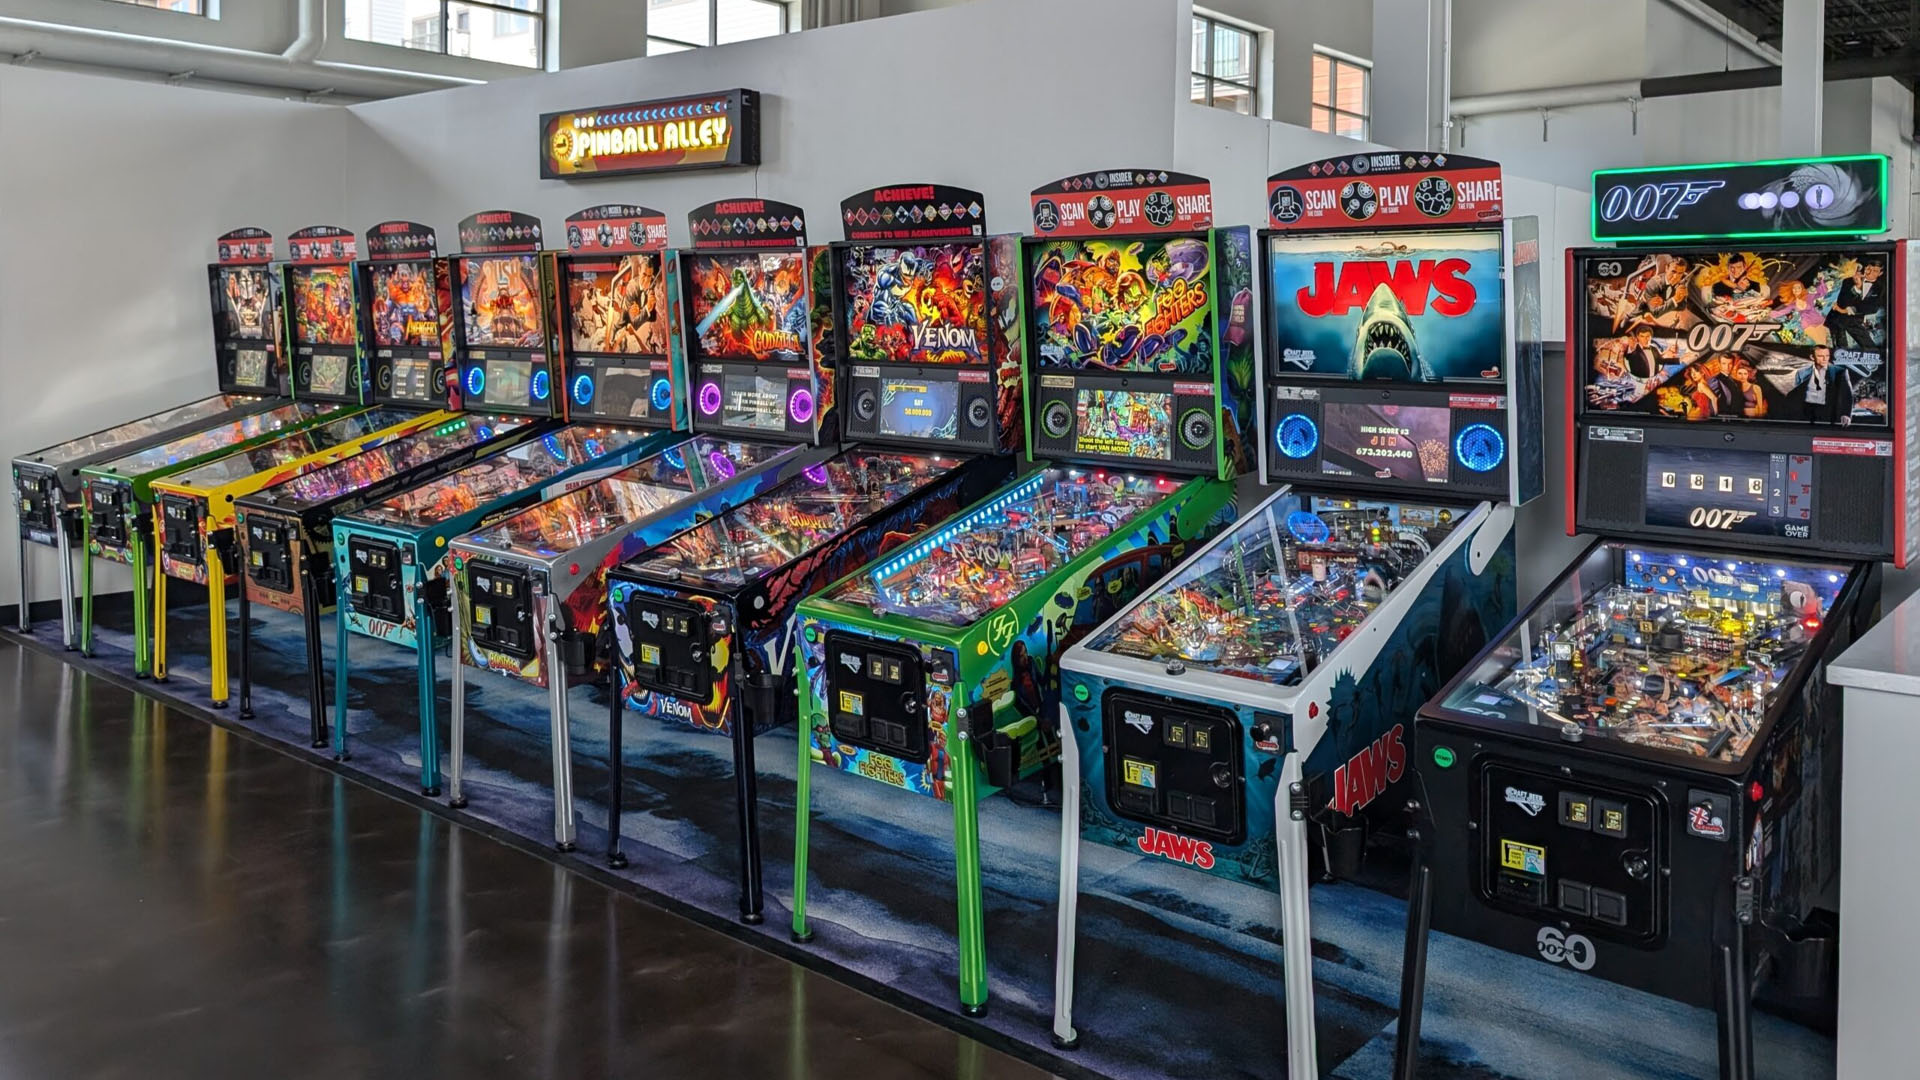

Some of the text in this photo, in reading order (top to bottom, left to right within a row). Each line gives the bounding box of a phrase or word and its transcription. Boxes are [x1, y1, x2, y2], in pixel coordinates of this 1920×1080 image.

[578, 118, 727, 157] PINBALL ALLEY
[1371, 154, 1400, 167] INSIDER
[1109, 172, 1133, 182] INSIDER
[874, 186, 935, 202] ACHIEVE!
[1306, 180, 1502, 210] SCAN PLAY SHARE
[1600, 182, 1695, 222] 007
[715, 201, 765, 214] ACHIEVE!
[1060, 194, 1211, 220] SCAN PLAY SHARE
[380, 223, 410, 233] ACHIEVE!
[477, 212, 512, 224] ACHIEVE!
[582, 224, 667, 241] SCAN PLAY SHARE
[851, 230, 882, 239] CONNECT
[884, 230, 892, 238] TO
[911, 227, 971, 237] ACHIEVEMENTS
[1598, 262, 1622, 276] 60
[1156, 278, 1188, 311] FOO
[1297, 258, 1477, 318] JAWS
[1144, 282, 1208, 337] FIGHTERS
[405, 315, 438, 340] AVENGERS
[911, 320, 979, 355] VENOM
[1688, 323, 1757, 351] 007
[753, 329, 803, 353] GODZILLA
[1360, 426, 1377, 434] HIGH
[1370, 436, 1397, 447] JIM
[1355, 448, 1413, 458] 673,202,440
[1666, 474, 1674, 485] 0
[1694, 475, 1703, 487] 8
[1752, 480, 1761, 491] 8
[1690, 506, 1740, 529] 007
[1773, 506, 1779, 514] 3
[1785, 524, 1808, 532] GAME
[369, 619, 393, 638] 007
[660, 698, 693, 722] VENOM
[868, 751, 893, 767] FOO
[859, 762, 905, 786] FIGHTERS
[1327, 723, 1406, 817] JAWS
[1137, 827, 1214, 869] JAWS
[1537, 926, 1596, 971] 60
